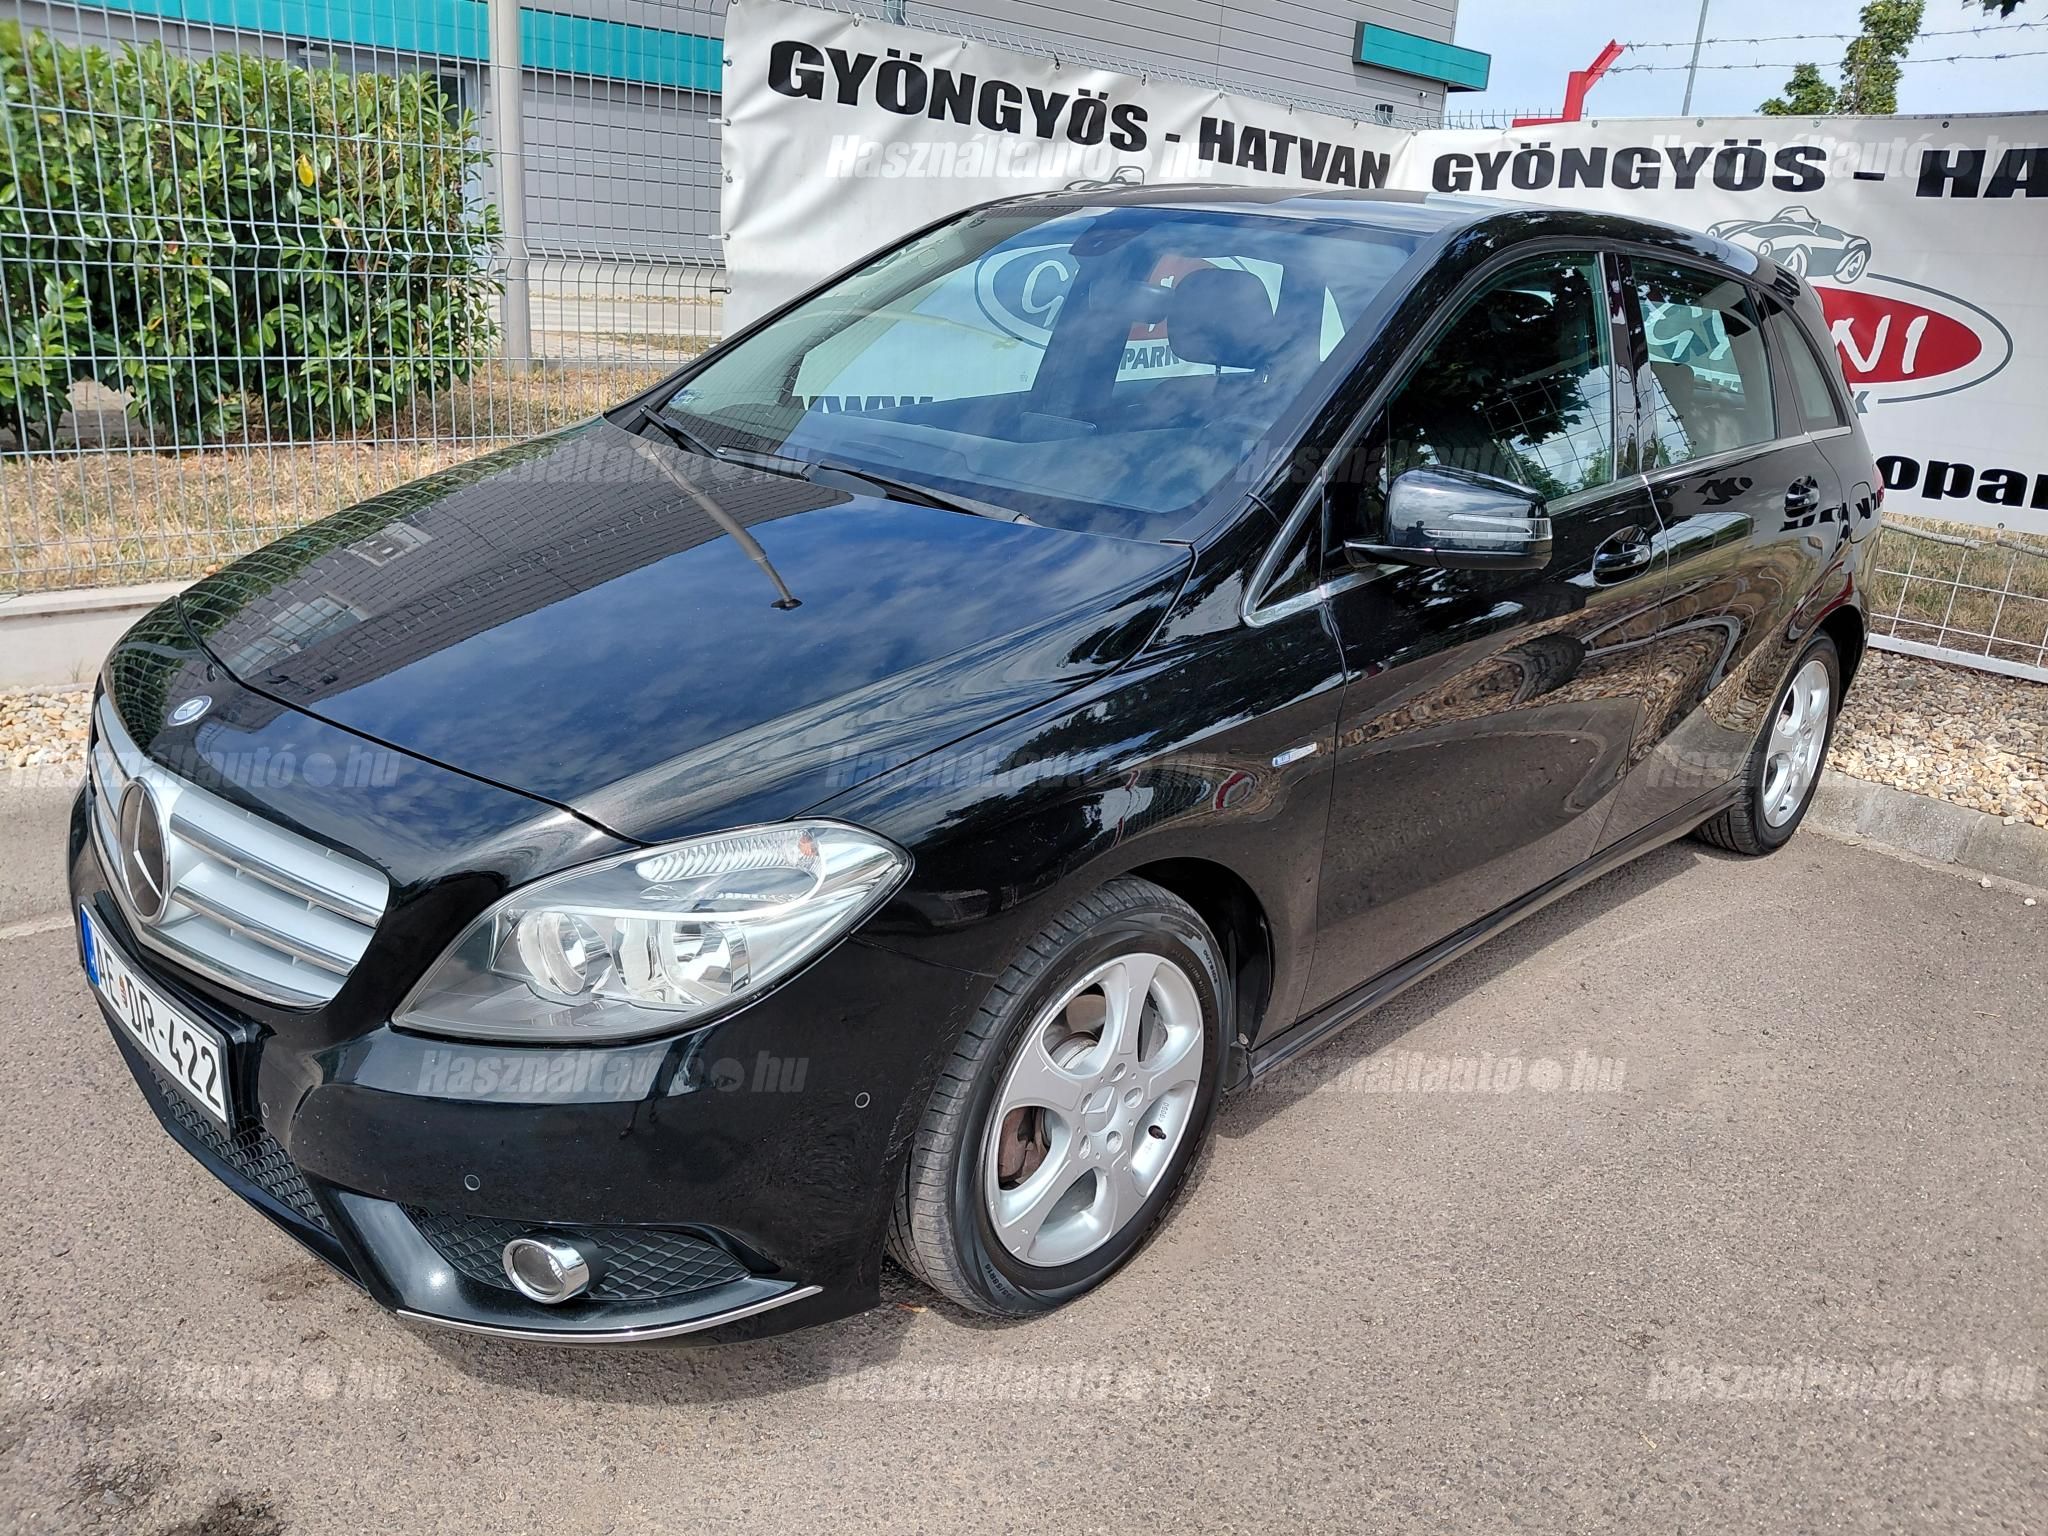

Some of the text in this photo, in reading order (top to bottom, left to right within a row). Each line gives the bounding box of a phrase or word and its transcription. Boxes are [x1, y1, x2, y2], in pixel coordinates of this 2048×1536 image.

[767, 40, 1148, 151] GYÖNGYÖS
[1198, 116, 1391, 188] HATVAN
[1431, 138, 1827, 192] GYÖNGYÖS
